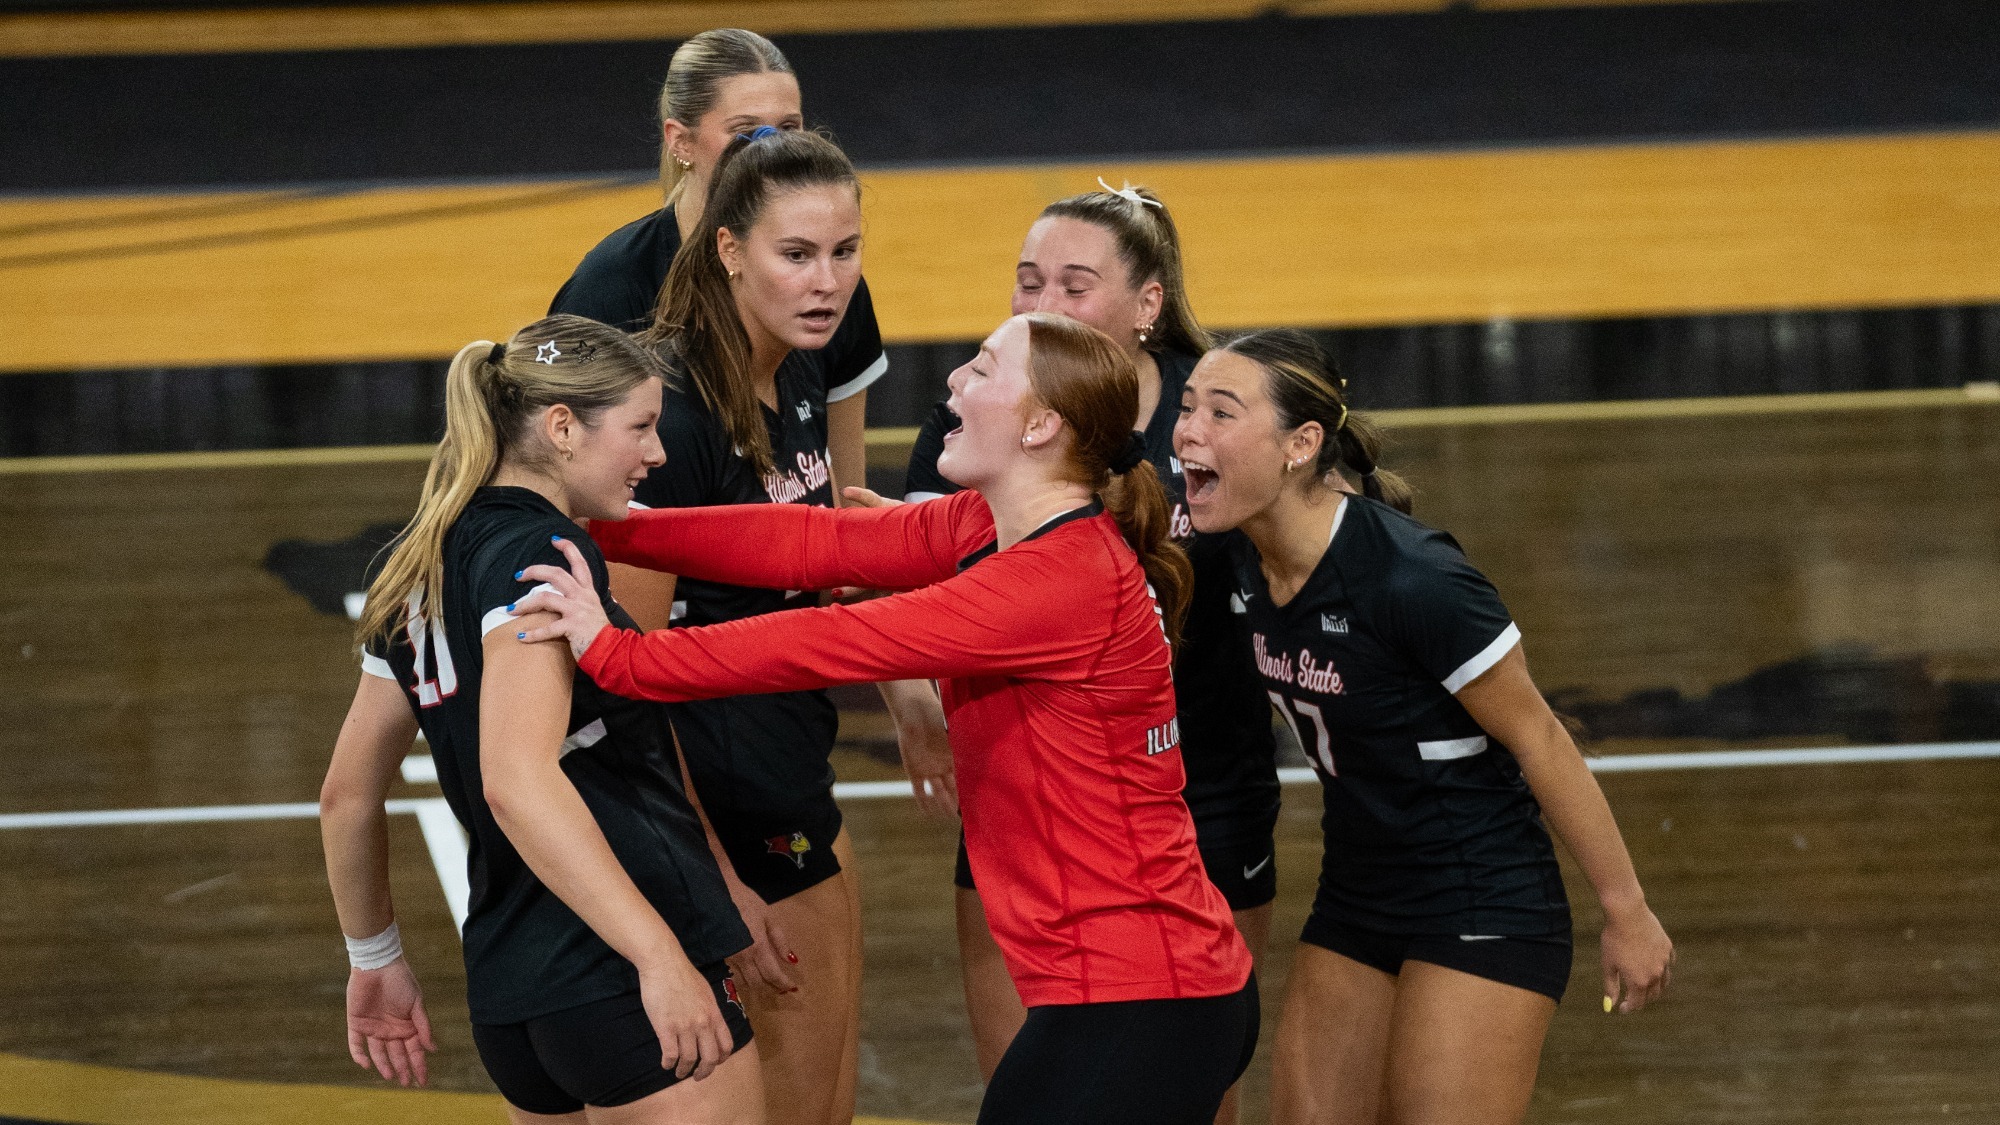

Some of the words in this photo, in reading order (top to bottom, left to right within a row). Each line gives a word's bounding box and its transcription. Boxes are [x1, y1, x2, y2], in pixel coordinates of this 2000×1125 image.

[1321, 612, 1349, 634] VALLEY
[1252, 632, 1294, 684] Illinois
[1297, 648, 1344, 695] State
[1147, 716, 1180, 756] ILLIN
[1267, 689, 1338, 777] 17
